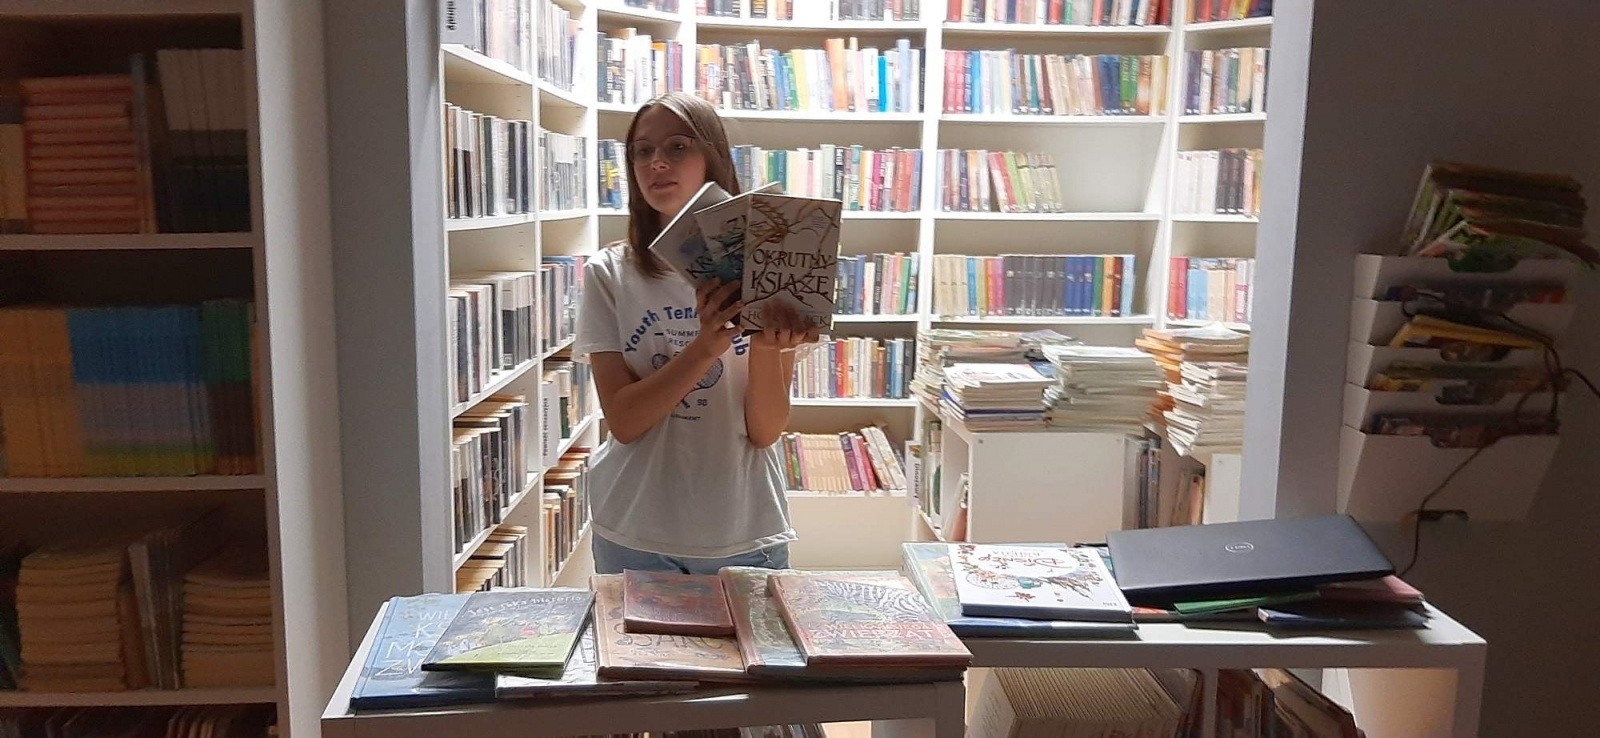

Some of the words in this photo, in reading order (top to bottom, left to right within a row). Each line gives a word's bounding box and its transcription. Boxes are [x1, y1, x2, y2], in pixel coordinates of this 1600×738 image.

[752, 248, 832, 269] OKRUTNY
[624, 309, 661, 354] Youth
[663, 305, 699, 321] Ten
[731, 333, 749, 356] ub
[913, 462, 921, 499] Dinosaury
[978, 553, 1072, 569] Disney
